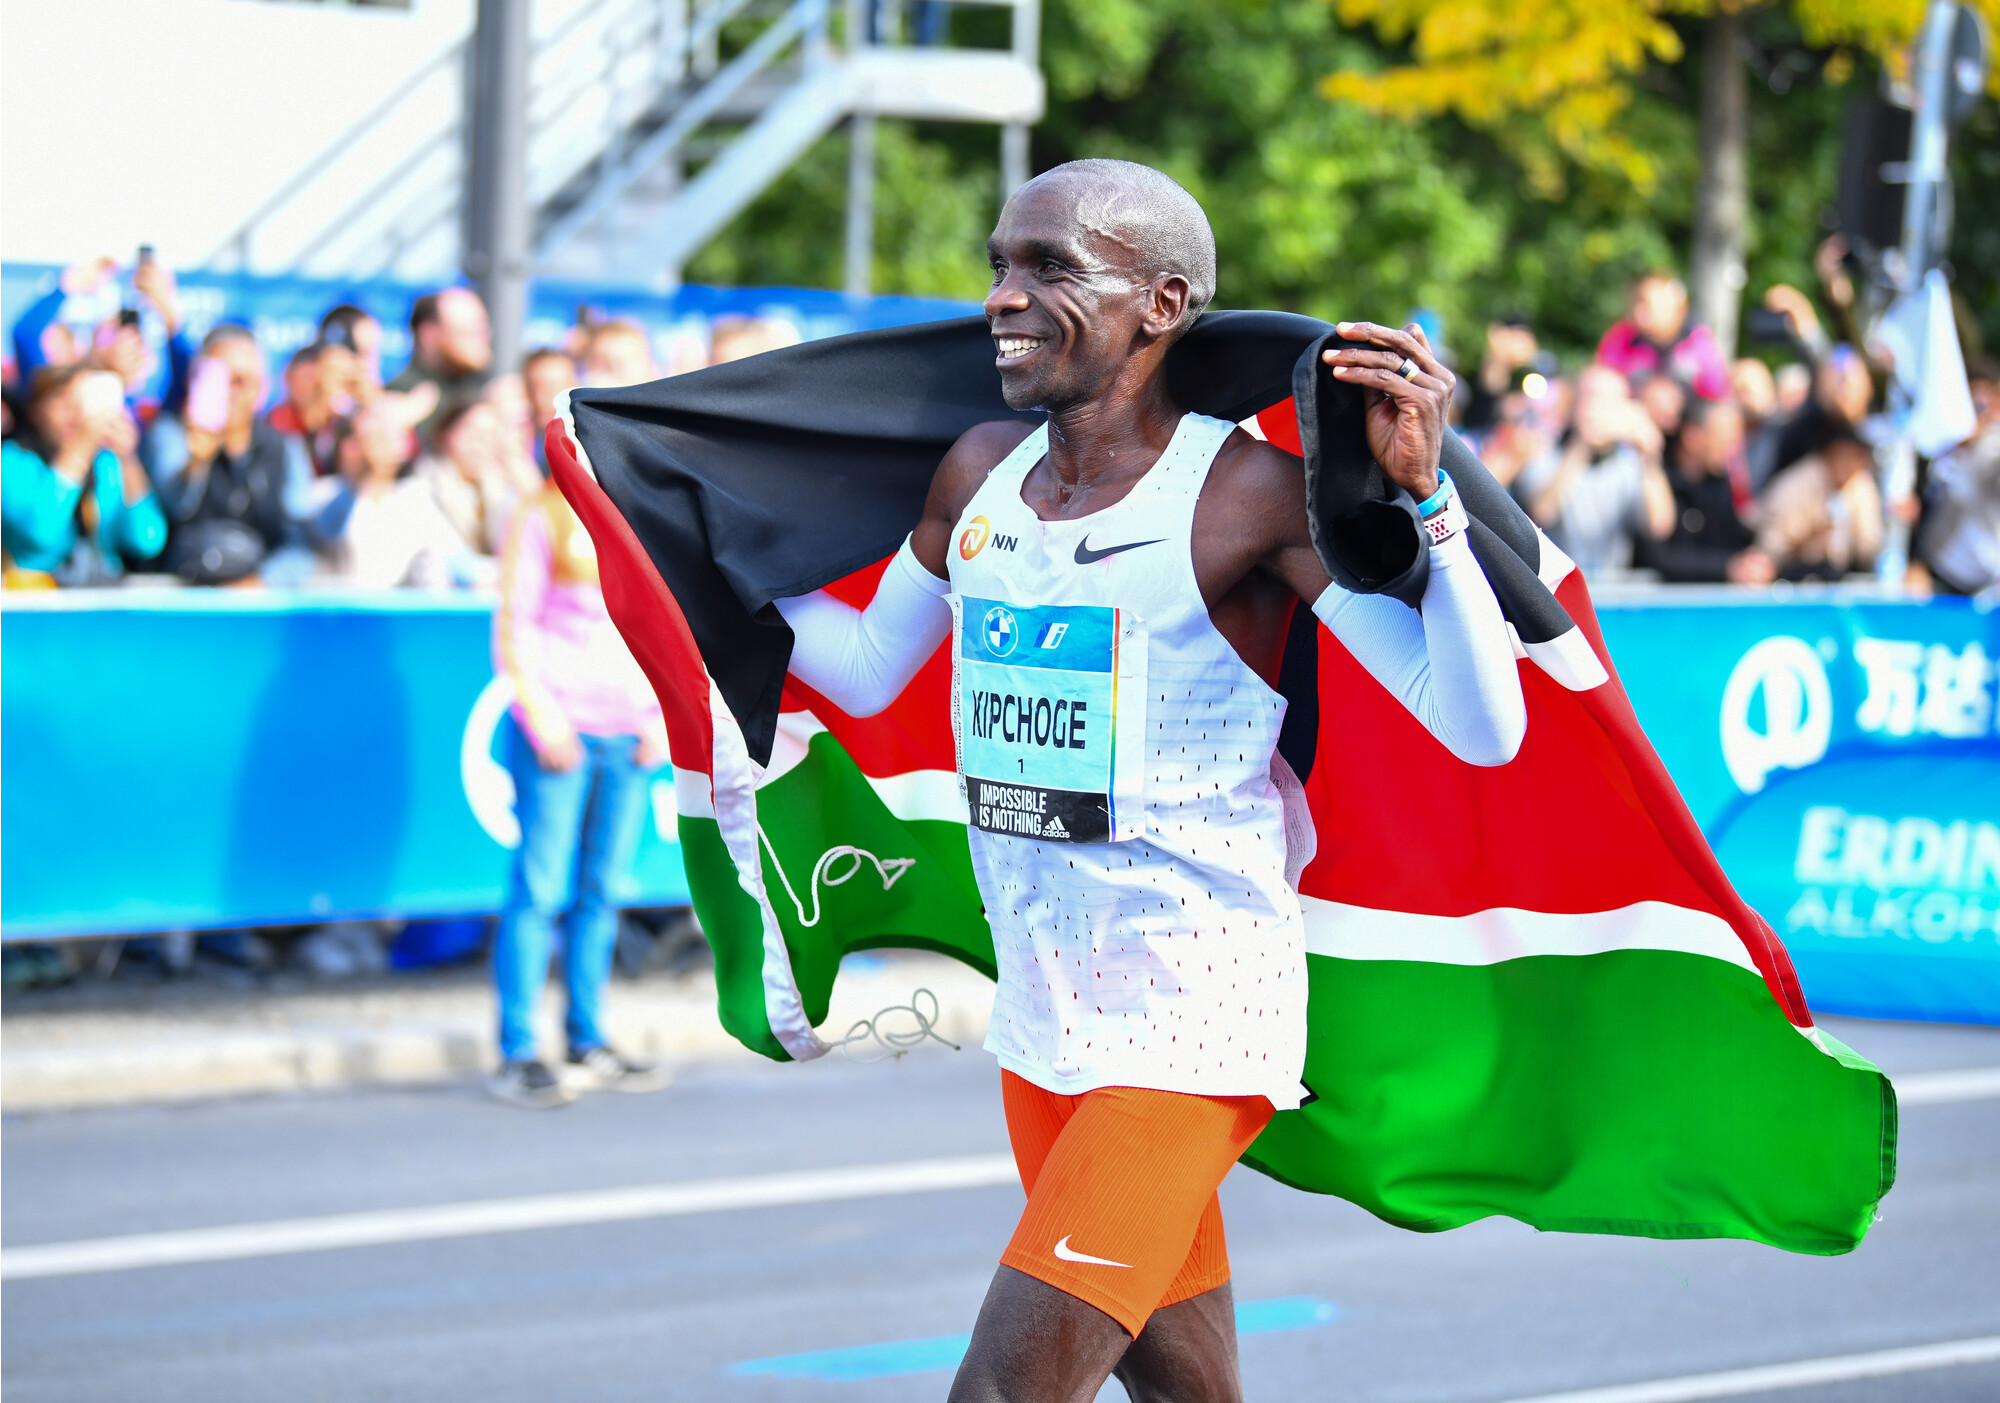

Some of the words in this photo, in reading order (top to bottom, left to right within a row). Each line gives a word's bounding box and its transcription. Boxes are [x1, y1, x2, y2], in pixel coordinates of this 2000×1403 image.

[991, 533, 1018, 552] NN
[987, 609, 1014, 624] BMW
[1853, 637, 2000, 740] 万达
[972, 689, 1087, 749] KIPCHOGE
[1017, 758, 1024, 774] 1
[980, 783, 1047, 814] IMPOSSIBLE
[979, 805, 991, 827] IS
[991, 808, 1042, 836] NOTHING
[1042, 829, 1070, 839] adidas
